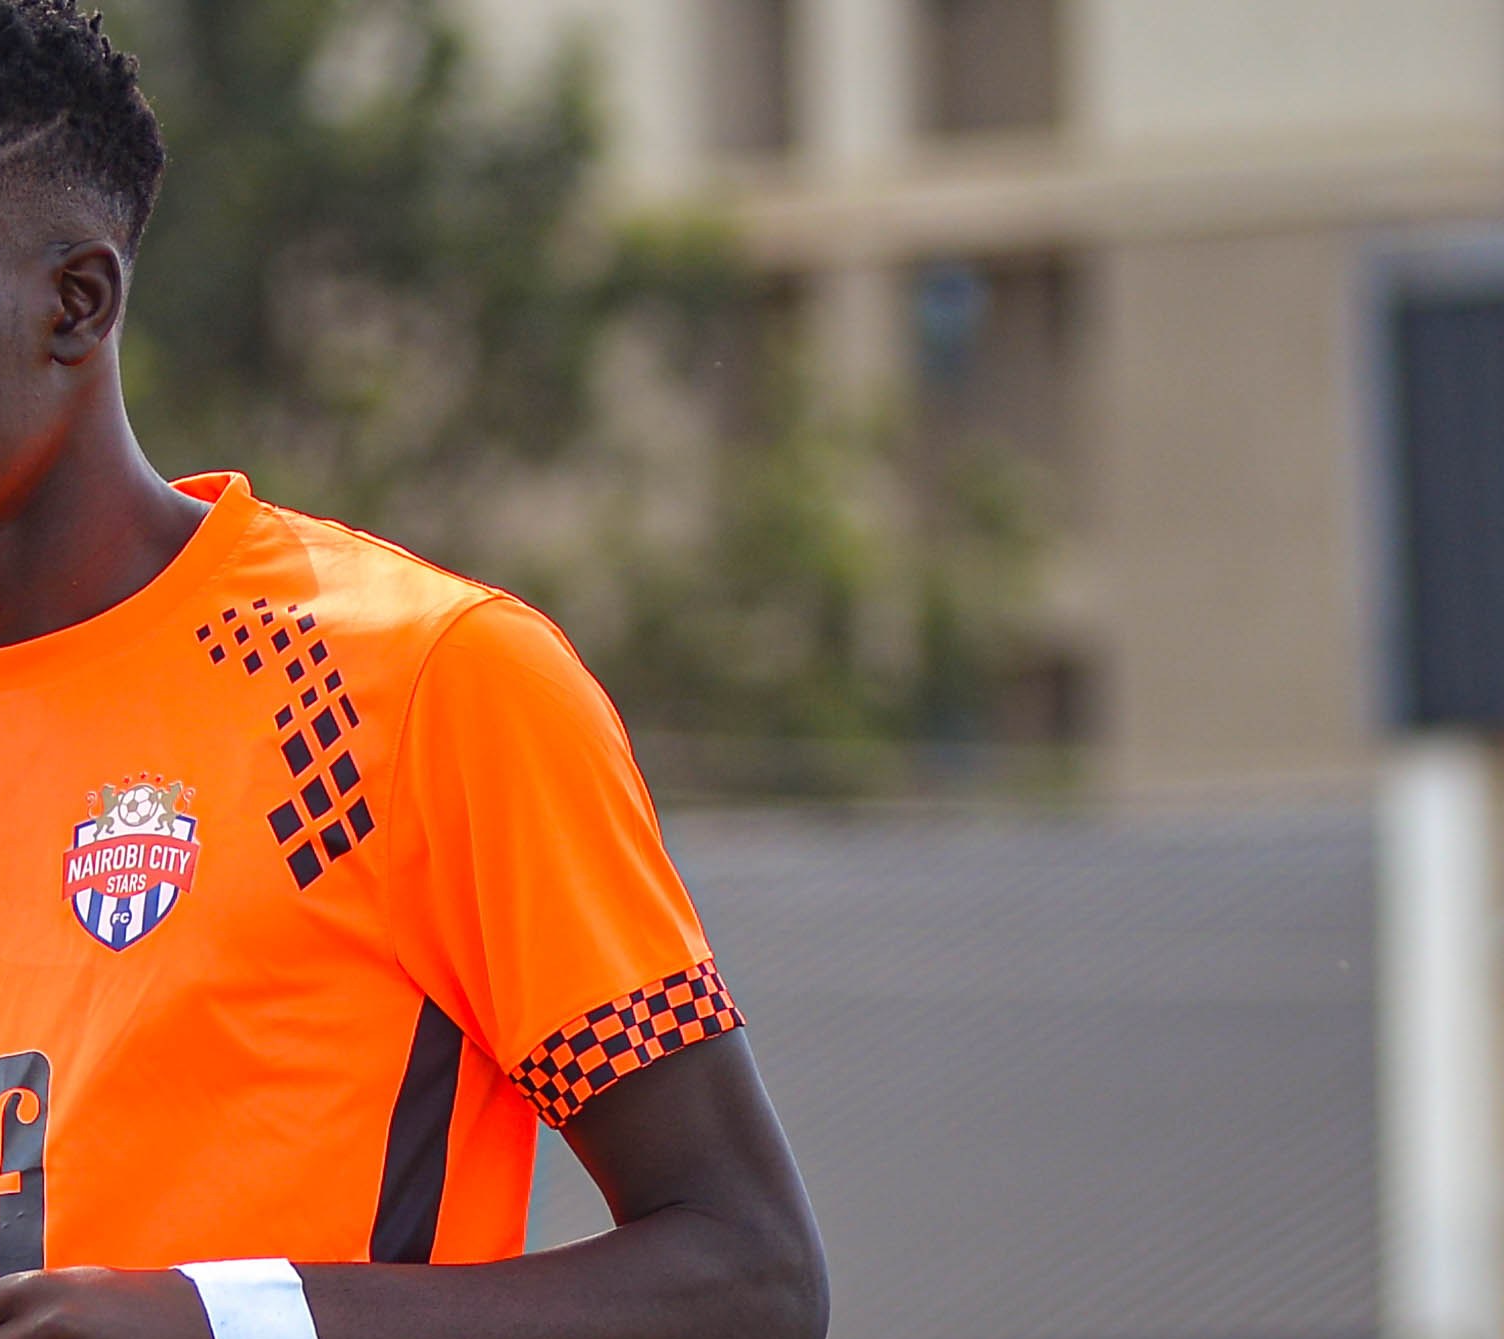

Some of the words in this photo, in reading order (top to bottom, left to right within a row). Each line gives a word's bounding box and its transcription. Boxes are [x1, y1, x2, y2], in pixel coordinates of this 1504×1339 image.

[67, 844, 145, 883] NAIROBI
[149, 845, 191, 875] CITY
[106, 874, 147, 894] STARS
[112, 912, 130, 924] FC
